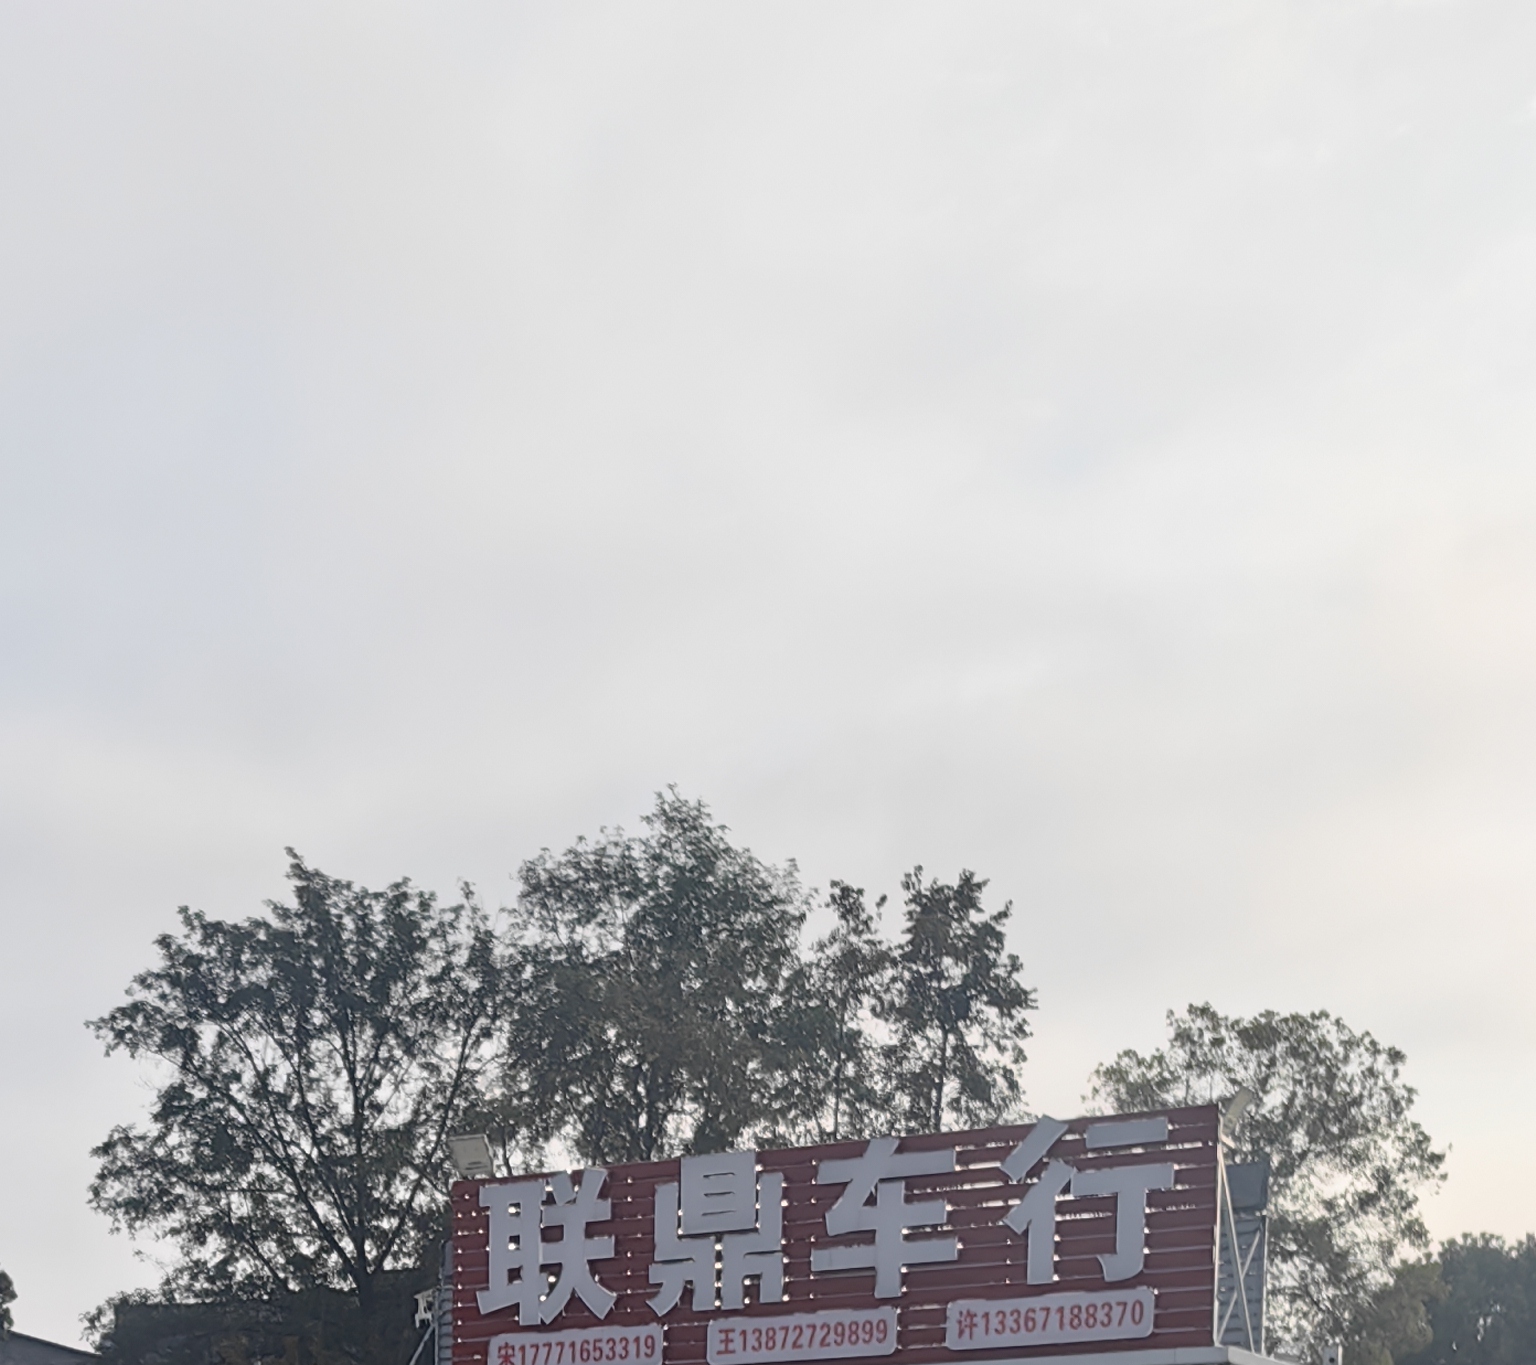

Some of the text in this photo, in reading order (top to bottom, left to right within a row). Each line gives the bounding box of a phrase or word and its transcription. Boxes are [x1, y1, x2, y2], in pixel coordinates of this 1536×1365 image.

[477, 1115, 1175, 1325] 联鼎车行
[716, 1318, 888, 1355] 王13872729899
[957, 1299, 1145, 1341] 许13367188370
